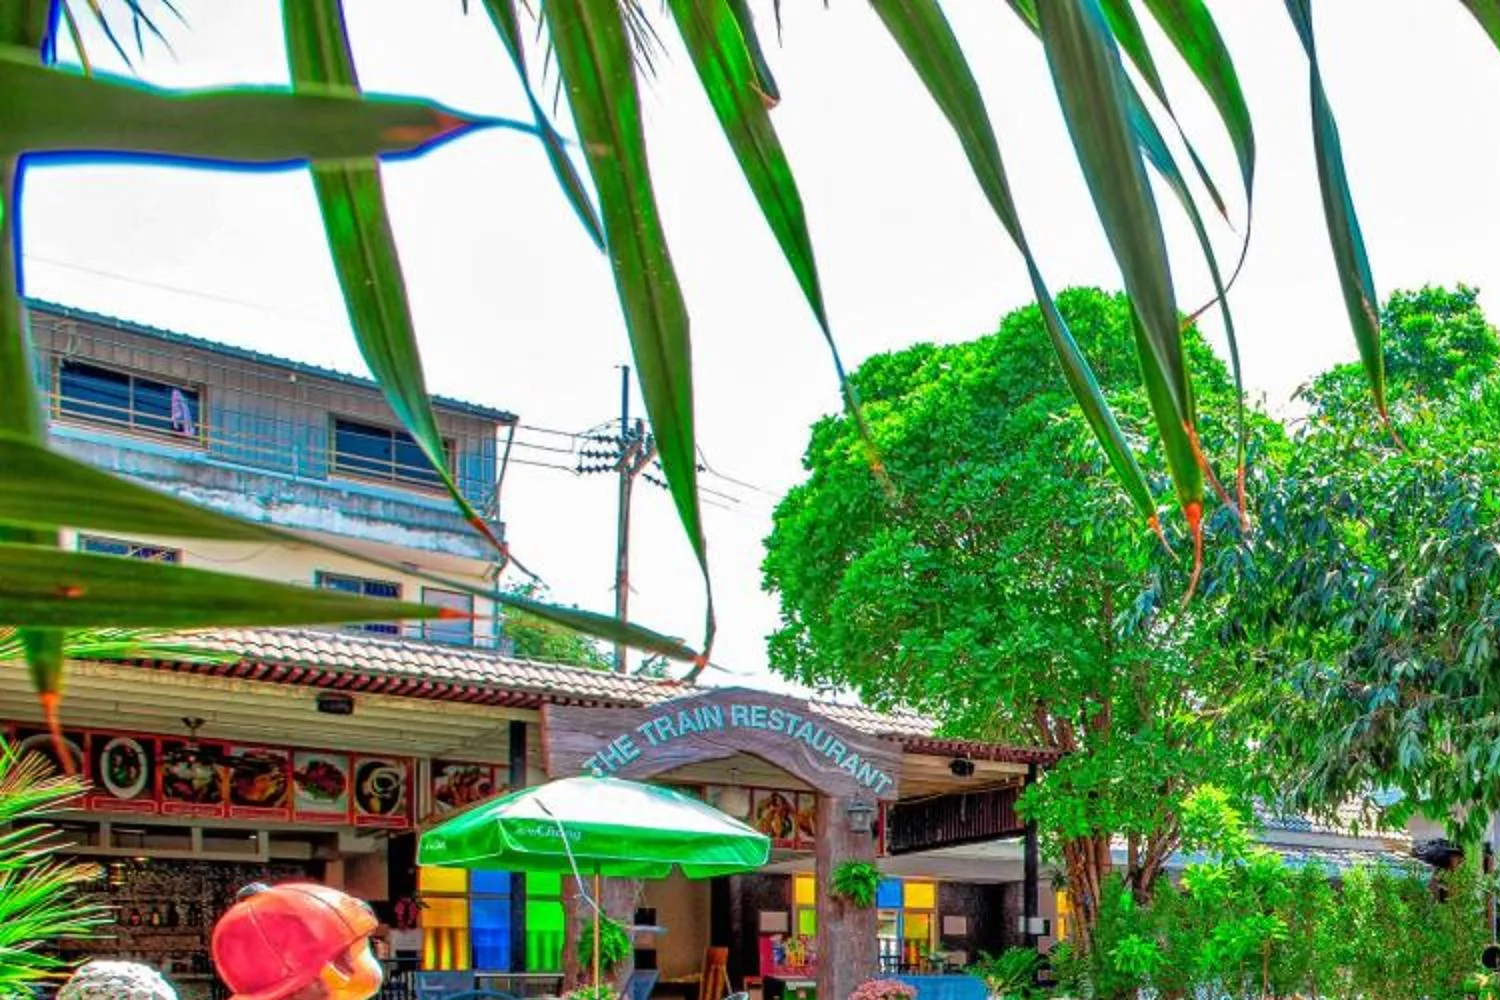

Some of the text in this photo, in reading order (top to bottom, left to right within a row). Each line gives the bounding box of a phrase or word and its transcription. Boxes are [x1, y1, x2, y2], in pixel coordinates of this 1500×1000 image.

[582, 703, 893, 795] THE TRAIN RESTAURANT
